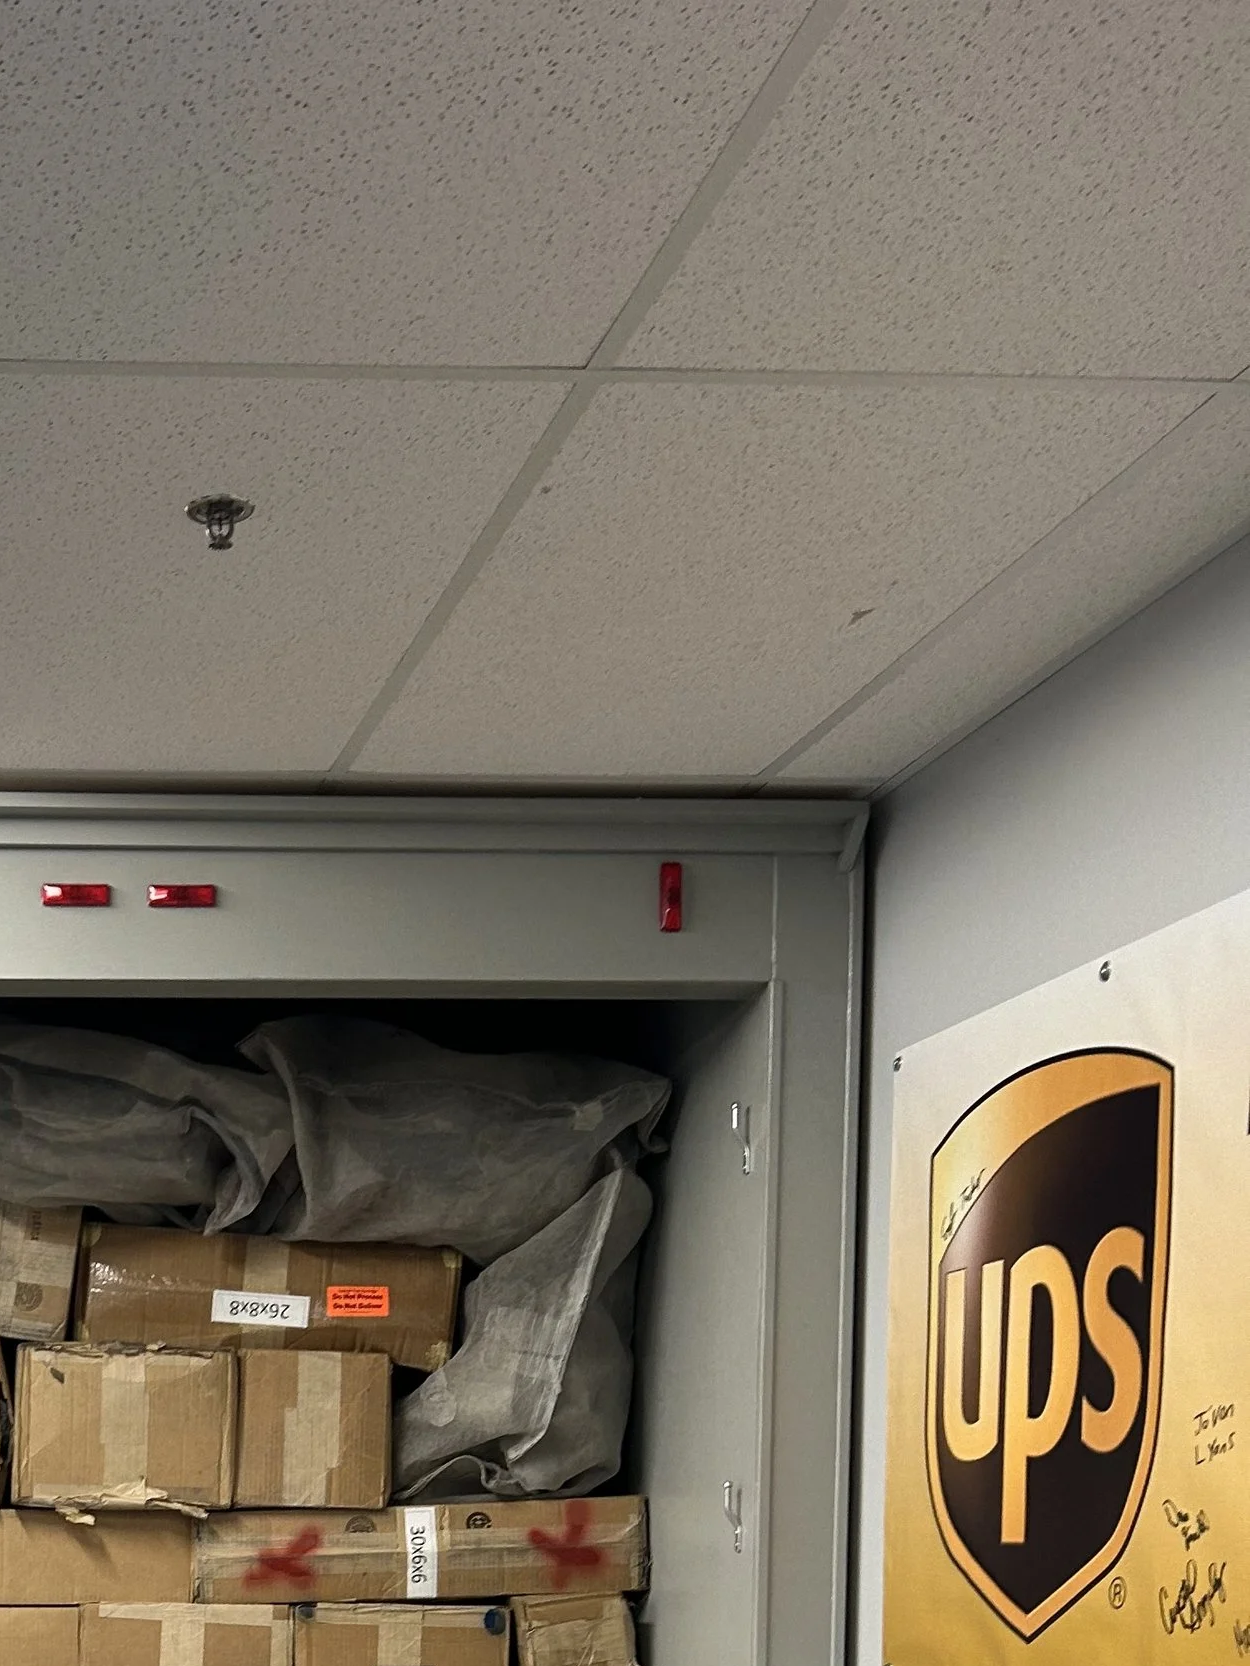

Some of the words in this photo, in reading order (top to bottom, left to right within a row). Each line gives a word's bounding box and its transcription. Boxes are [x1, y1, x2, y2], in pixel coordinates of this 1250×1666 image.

[229, 1300, 291, 1320] 26x8x8
[943, 1226, 1145, 1543] ups
[410, 1526, 427, 1584] 30x6x6
